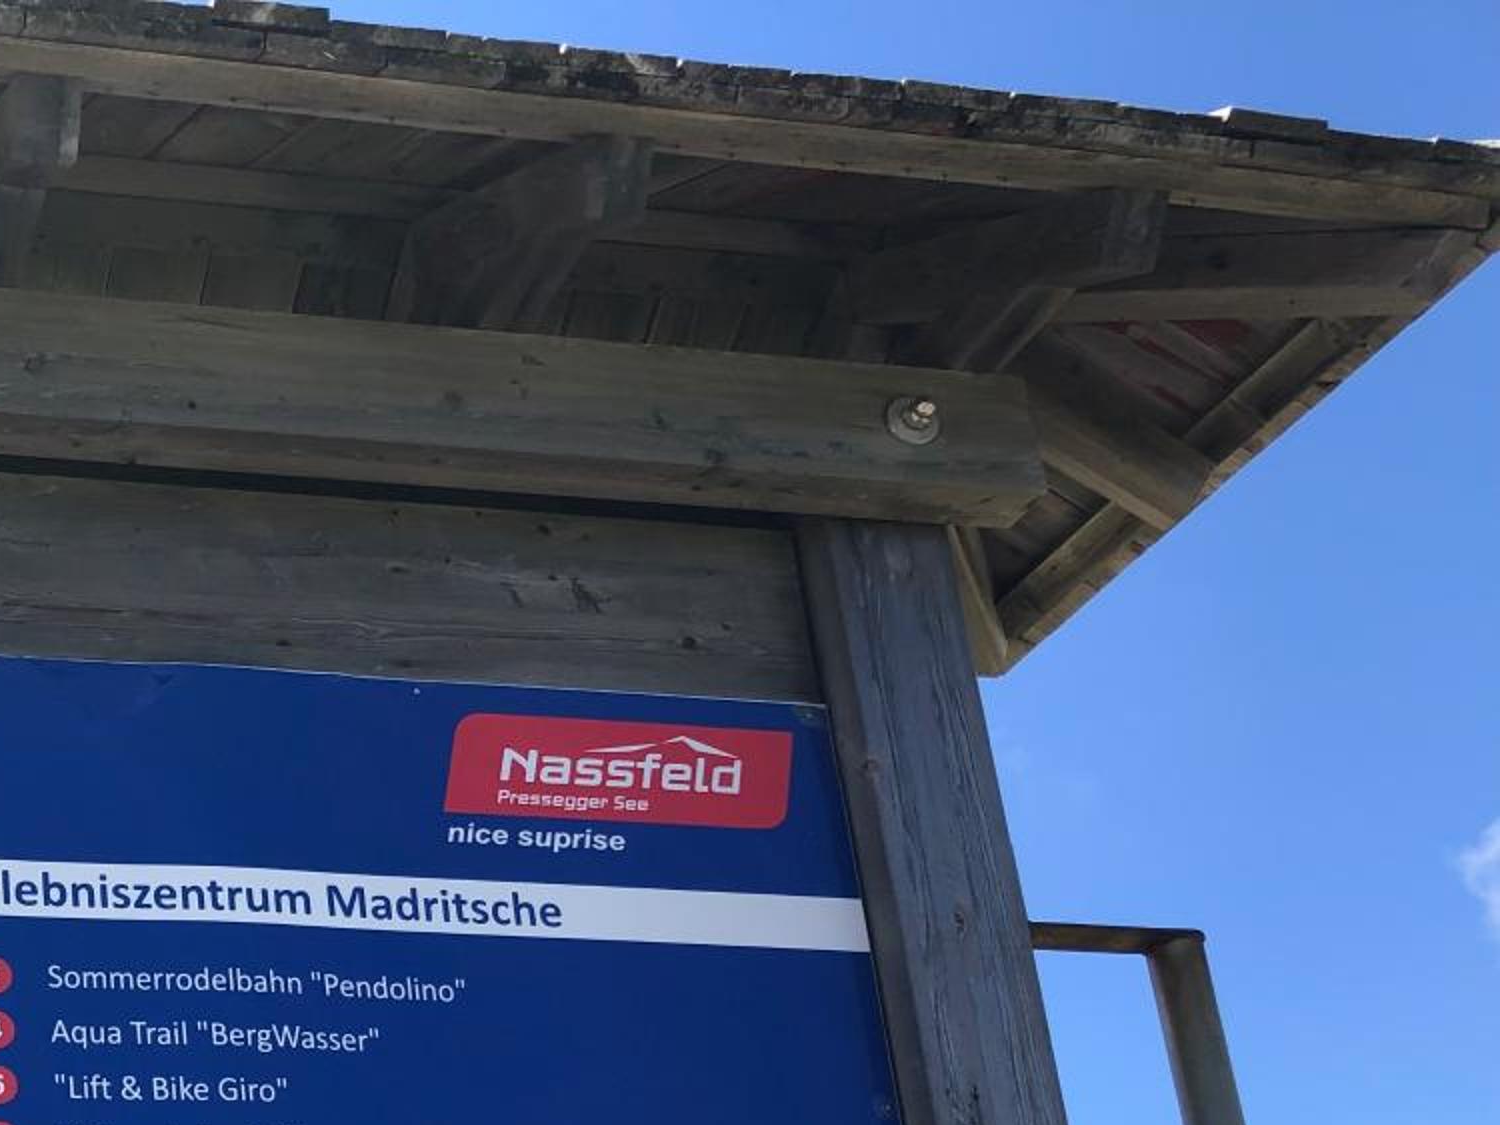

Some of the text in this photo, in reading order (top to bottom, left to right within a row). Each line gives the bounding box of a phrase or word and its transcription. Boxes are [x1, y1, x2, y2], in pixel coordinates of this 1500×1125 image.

[500, 747, 742, 796] Nassfeld
[497, 789, 649, 812] Pressegger See
[447, 822, 626, 853] nice suprise
[326, 884, 563, 929] Madritsche
[47, 964, 303, 995] Sommerrodelbahn
[310, 971, 465, 1003] "Pendolino"
[51, 1019, 122, 1050] Aqua
[129, 1020, 188, 1046] Trail
[196, 1020, 379, 1053] "BergWasser"
[54, 1073, 113, 1100] "Lift
[121, 1075, 143, 1101] &
[152, 1075, 209, 1101] Bike
[218, 1077, 287, 1103] Giro"
